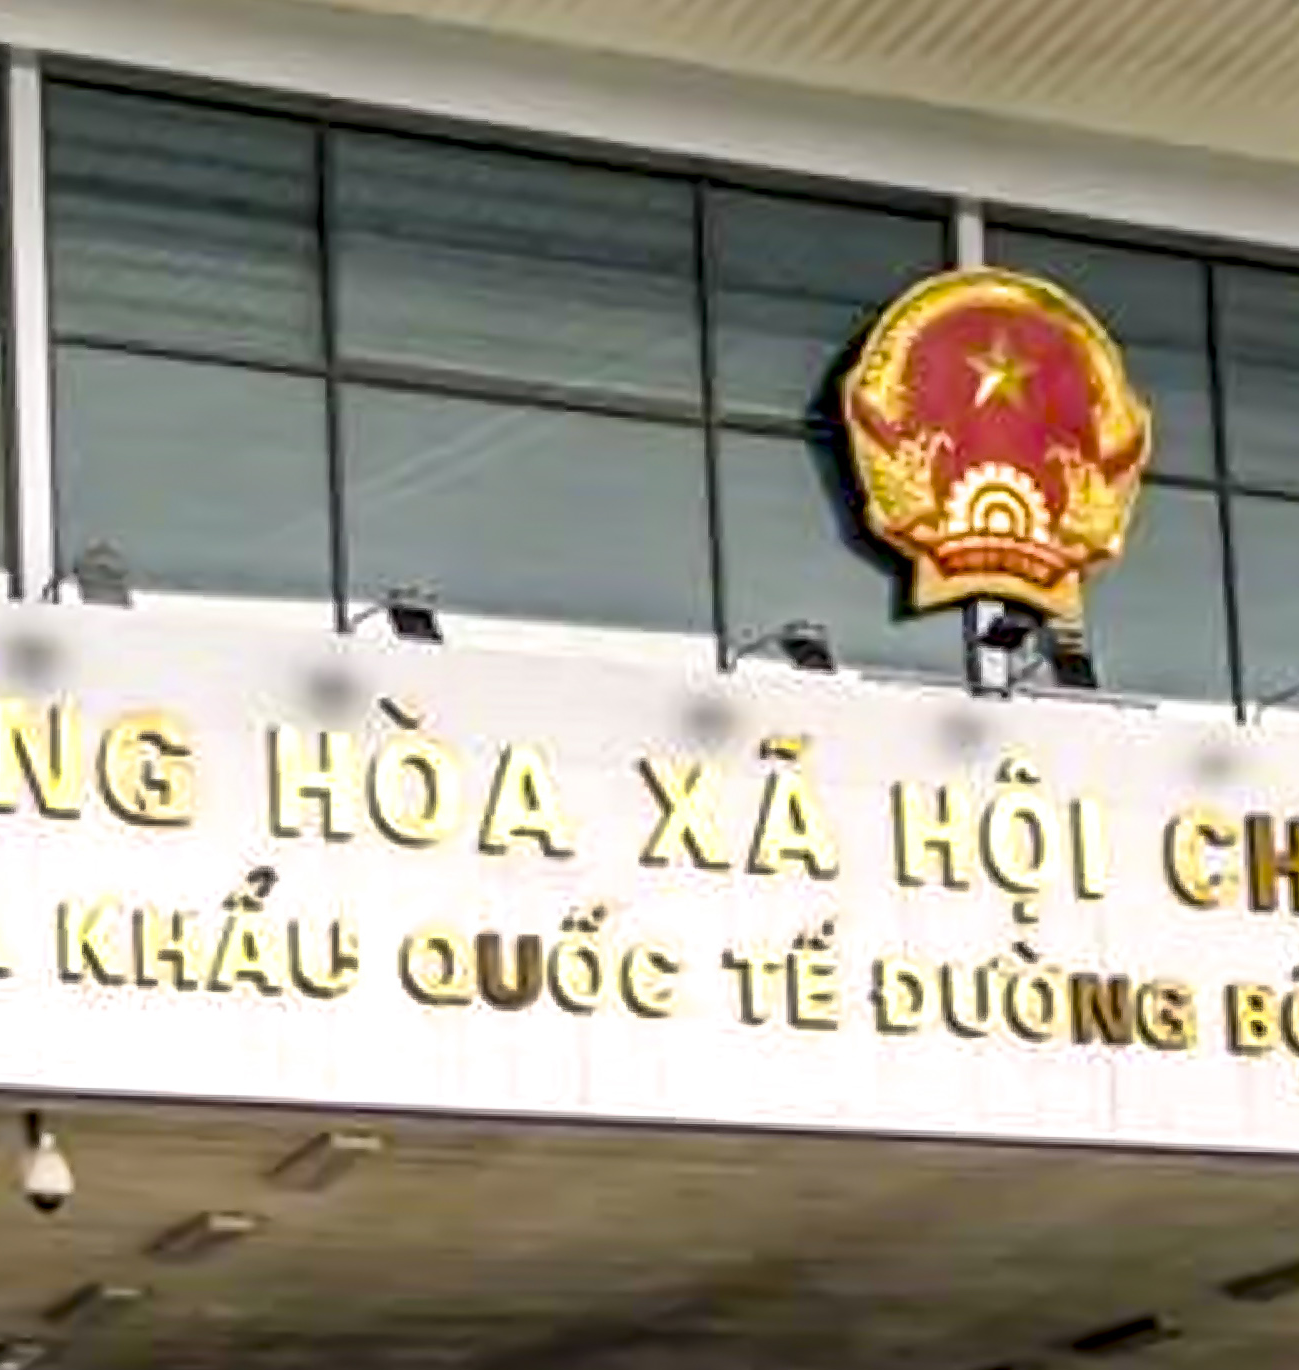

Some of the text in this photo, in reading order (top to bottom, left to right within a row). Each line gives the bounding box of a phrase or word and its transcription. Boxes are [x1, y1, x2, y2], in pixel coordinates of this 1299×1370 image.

[265, 697, 576, 858] HÒA
[636, 734, 840, 881] XÃ
[891, 754, 1104, 924] HỘI
[56, 865, 359, 1000] KHẨU
[398, 905, 683, 1018] QUỐC
[722, 921, 840, 1031] TẾ
[868, 940, 1199, 1051] ĐƯỜNG
